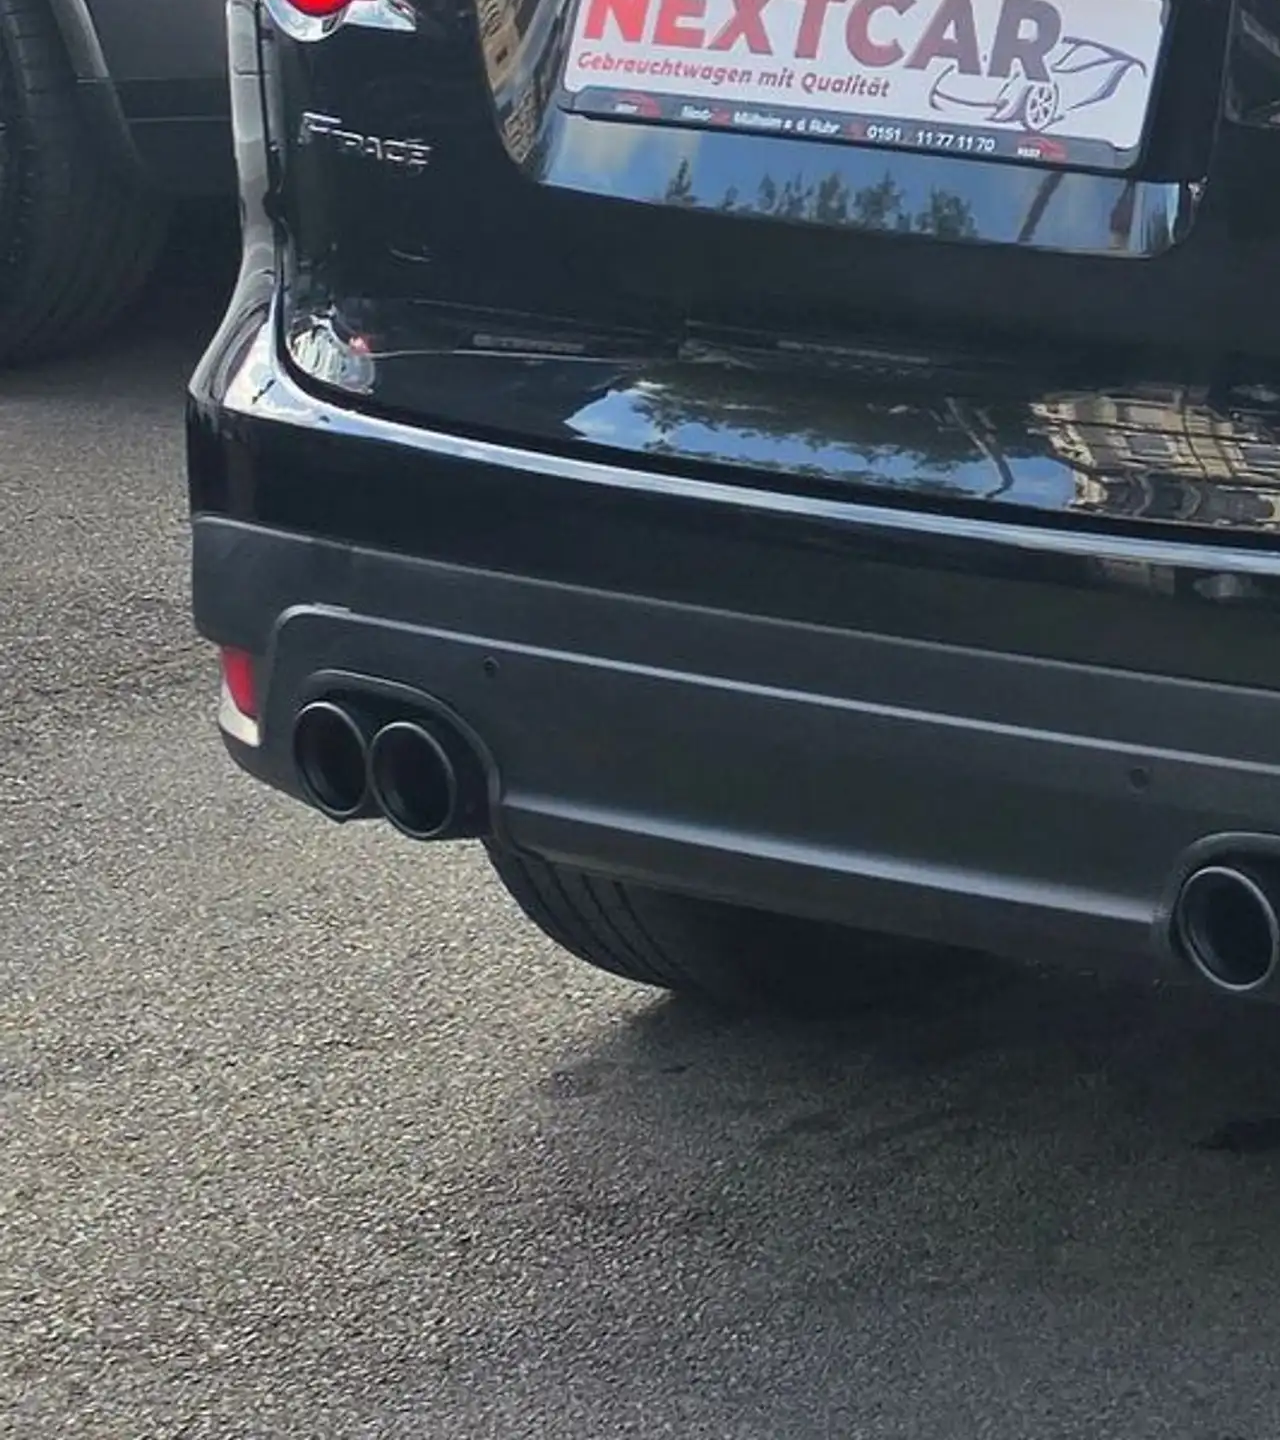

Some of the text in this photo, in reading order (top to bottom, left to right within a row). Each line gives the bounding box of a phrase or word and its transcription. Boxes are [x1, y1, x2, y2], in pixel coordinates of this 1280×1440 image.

[577, 51, 891, 98] Gebrauchtwagen mit Qualität
